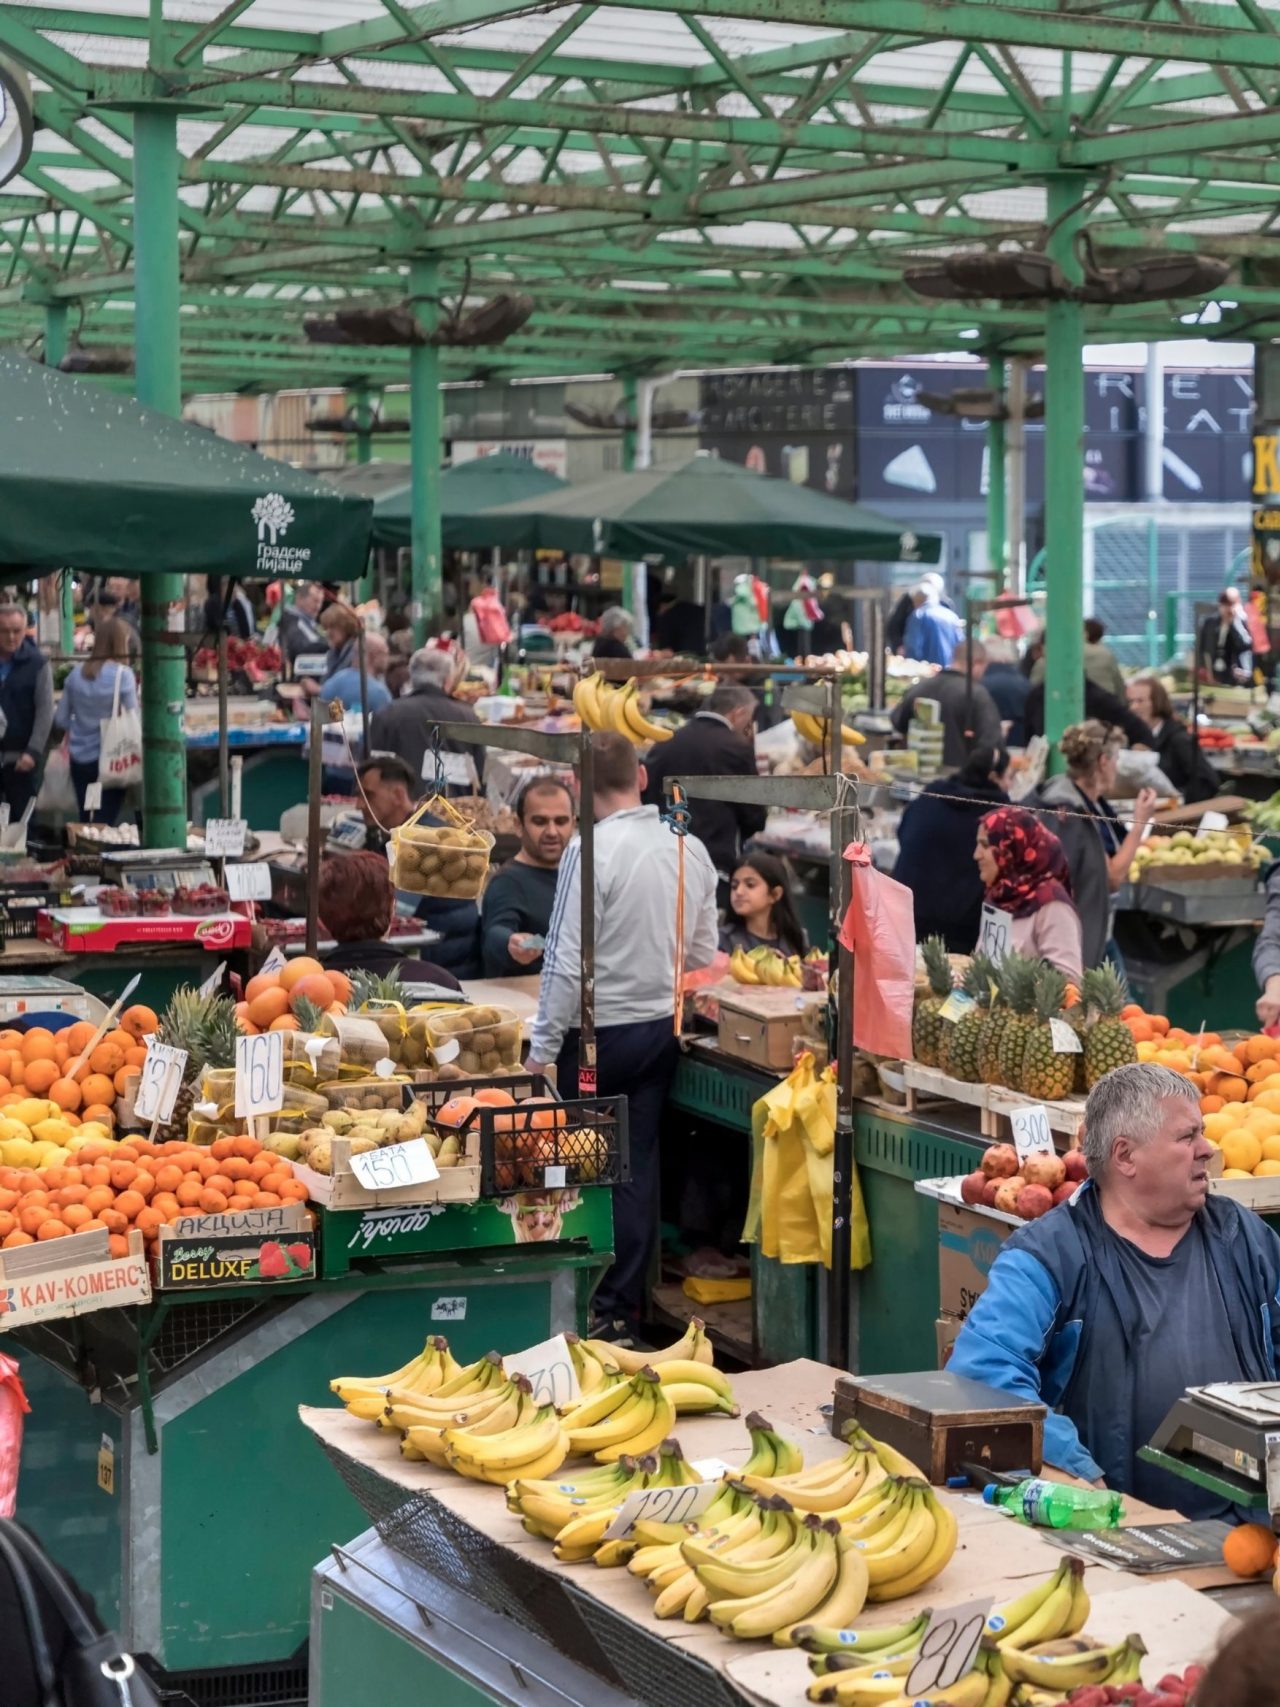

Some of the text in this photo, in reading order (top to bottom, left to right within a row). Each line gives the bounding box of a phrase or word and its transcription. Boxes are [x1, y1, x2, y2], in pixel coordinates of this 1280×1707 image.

[256, 557, 304, 574] пијаце
[257, 542, 312, 560] Градске
[239, 1031, 282, 1105] 160
[1014, 1112, 1050, 1148] 300
[361, 1153, 414, 1188] 150
[178, 1207, 284, 1235] АКЦИЈА
[20, 1264, 140, 1308] KAV-KOMERC
[172, 1260, 253, 1282] DELUXE
[100, 1463, 112, 1488] 137
[904, 1613, 987, 1698] 80
